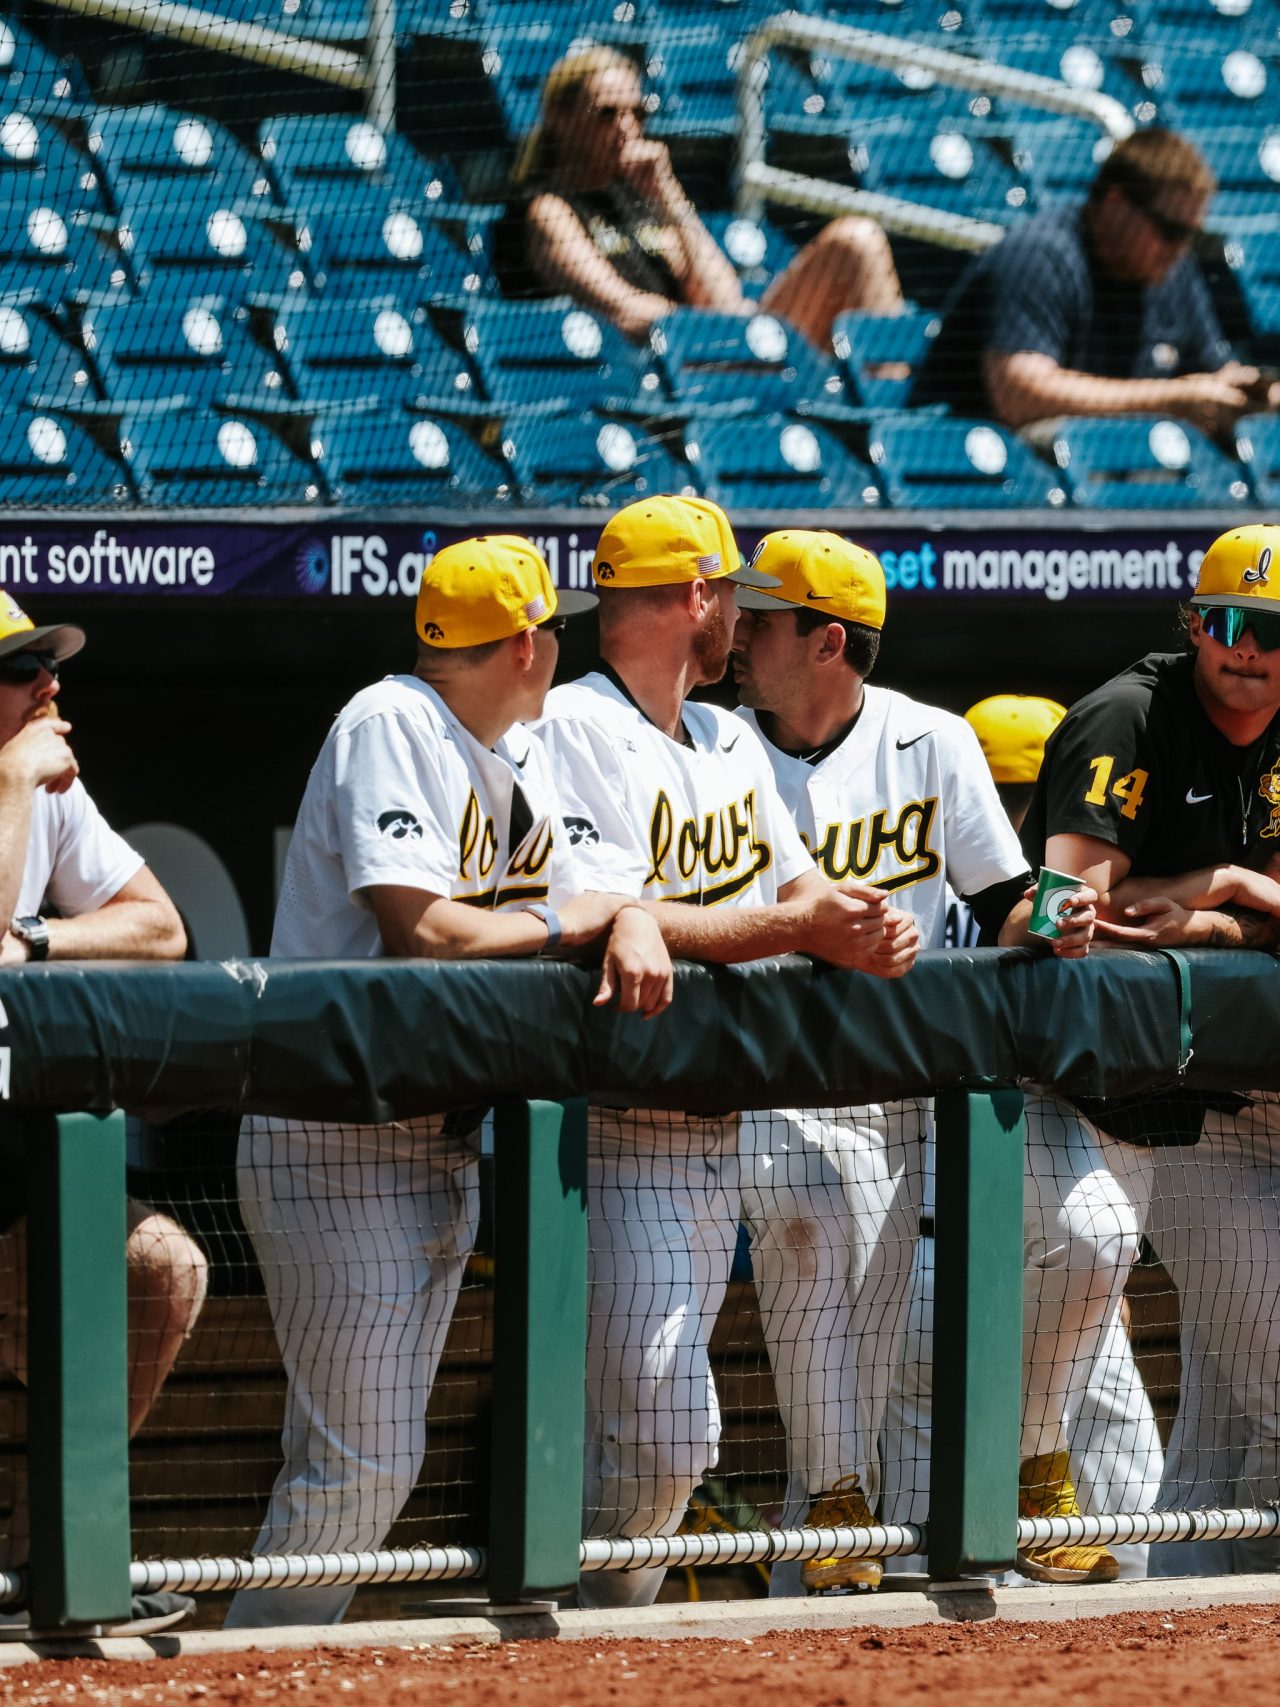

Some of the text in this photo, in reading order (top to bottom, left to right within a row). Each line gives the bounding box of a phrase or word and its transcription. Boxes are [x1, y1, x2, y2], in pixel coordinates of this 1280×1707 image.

[48, 529, 214, 585] software
[879, 541, 937, 590] set
[943, 540, 1183, 601] management
[1083, 755, 1149, 821] 14
